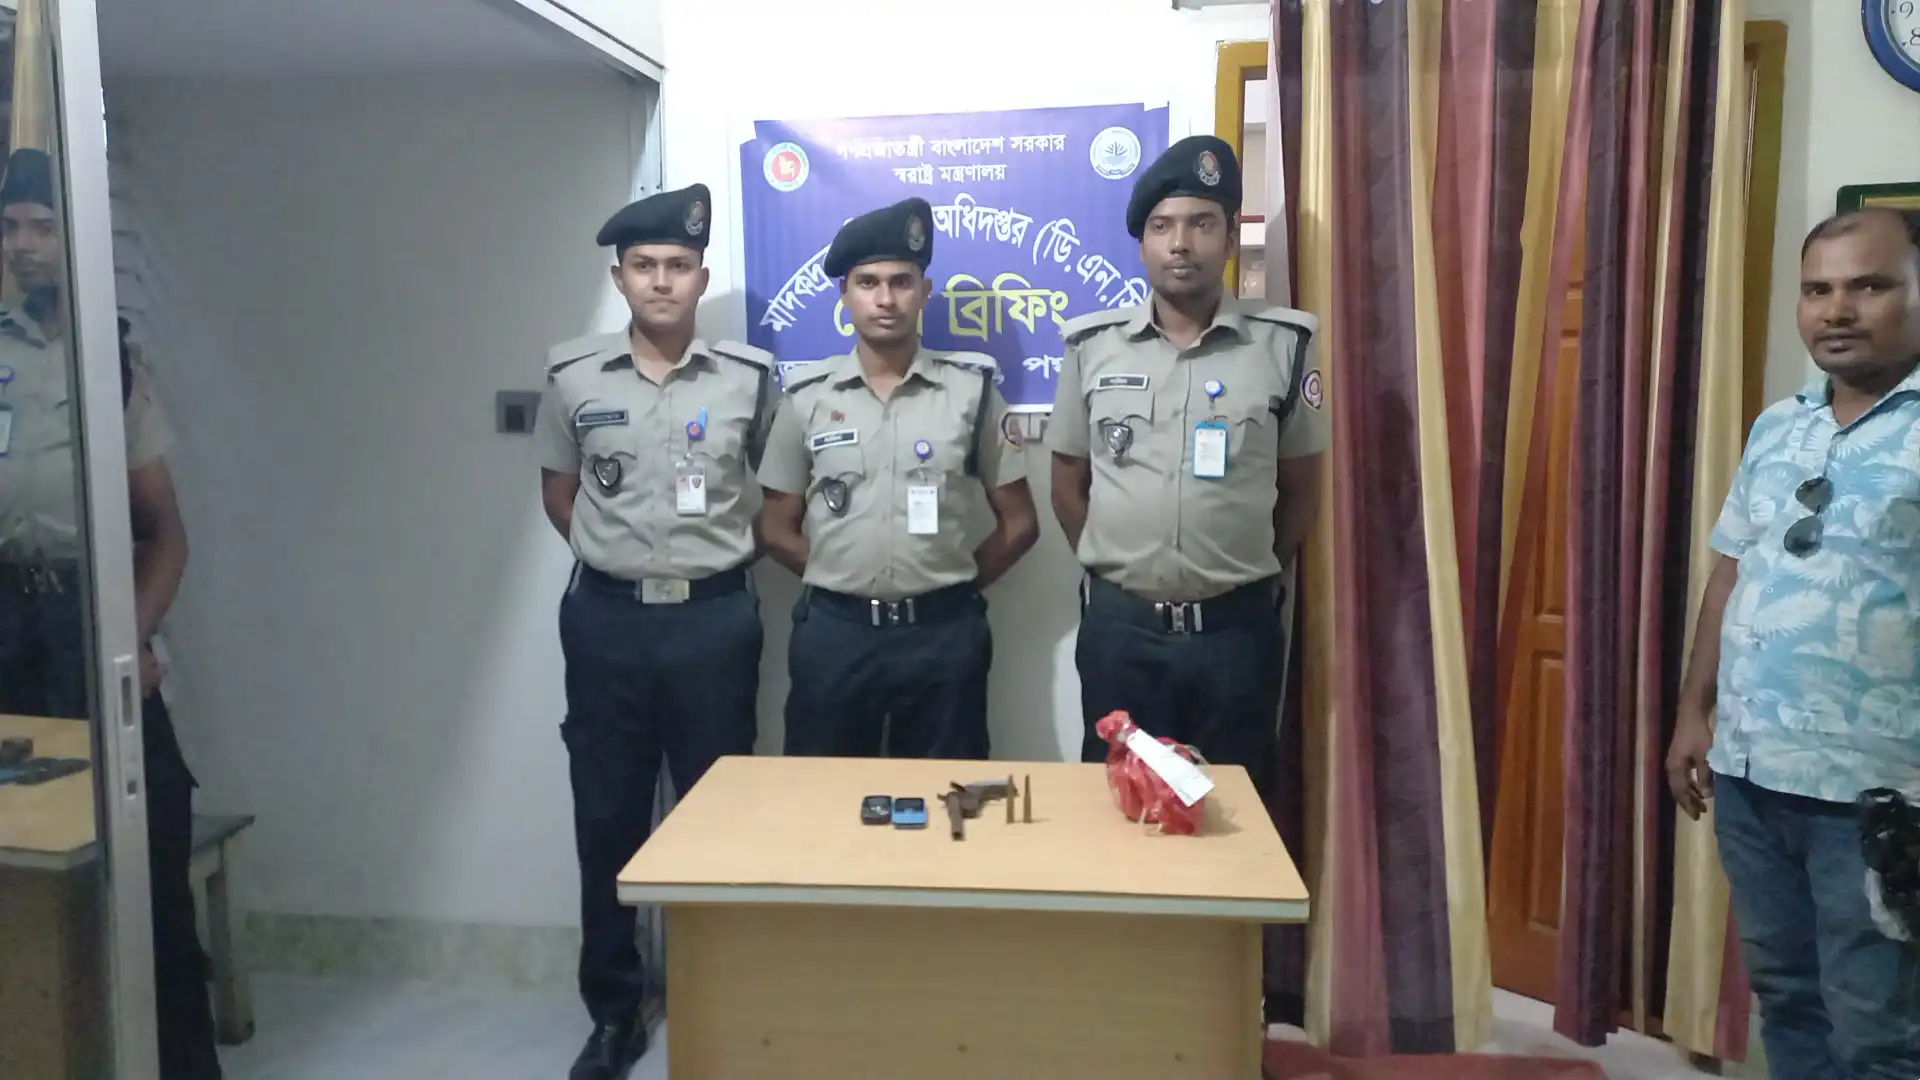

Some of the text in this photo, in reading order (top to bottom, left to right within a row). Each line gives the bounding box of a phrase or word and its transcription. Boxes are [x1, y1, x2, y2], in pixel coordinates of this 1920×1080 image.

[1899, 1, 1914, 19] 9
[929, 135, 1005, 157] বাংলাদেশ
[1010, 133, 1067, 153] সরকার
[759, 243, 836, 332] মাদকদ্র
[931, 192, 1034, 249] অধিদপ্তর
[941, 272, 1069, 343] ব্রিফিং
